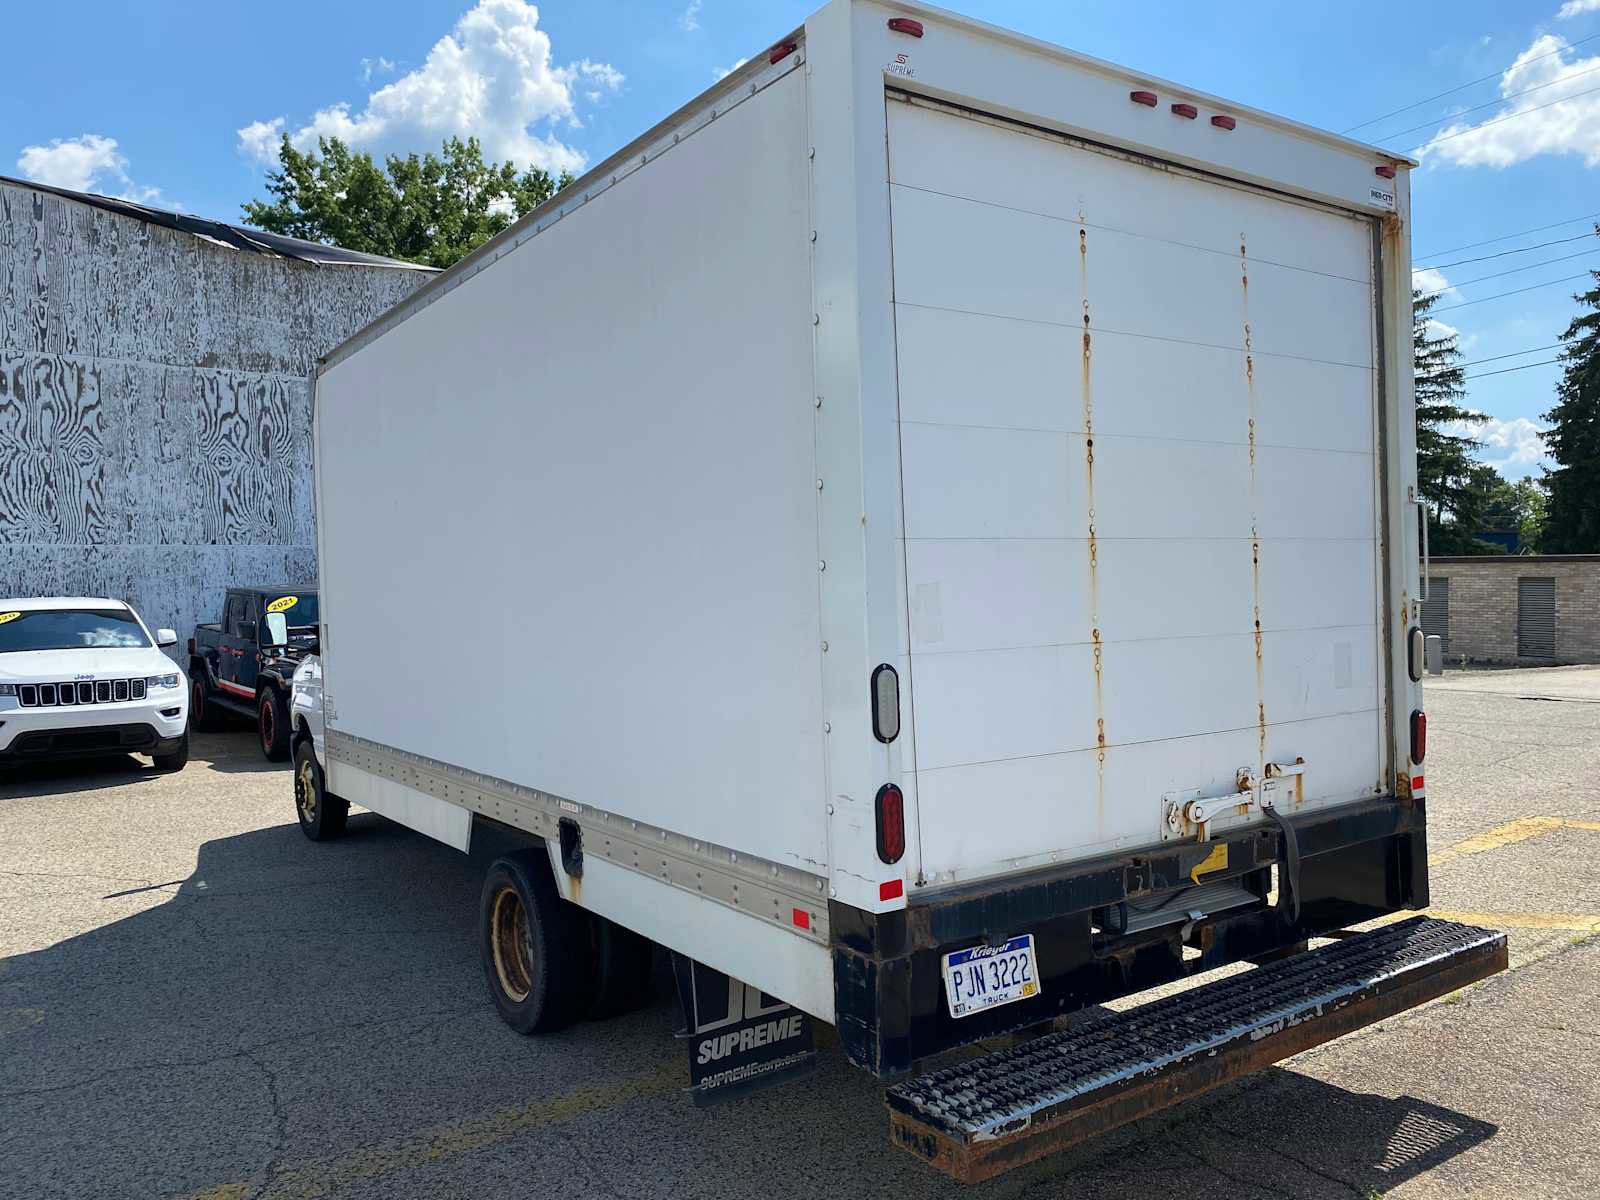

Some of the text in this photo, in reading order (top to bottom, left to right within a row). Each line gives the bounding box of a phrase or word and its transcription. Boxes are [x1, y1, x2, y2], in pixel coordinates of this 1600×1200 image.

[886, 63, 916, 78] SUPREME
[271, 597, 294, 610] 2021
[74, 673, 95, 681] Jeep
[989, 953, 1031, 991] 3222
[983, 993, 1009, 1005] TRUCK
[697, 1014, 803, 1065] SUPREME
